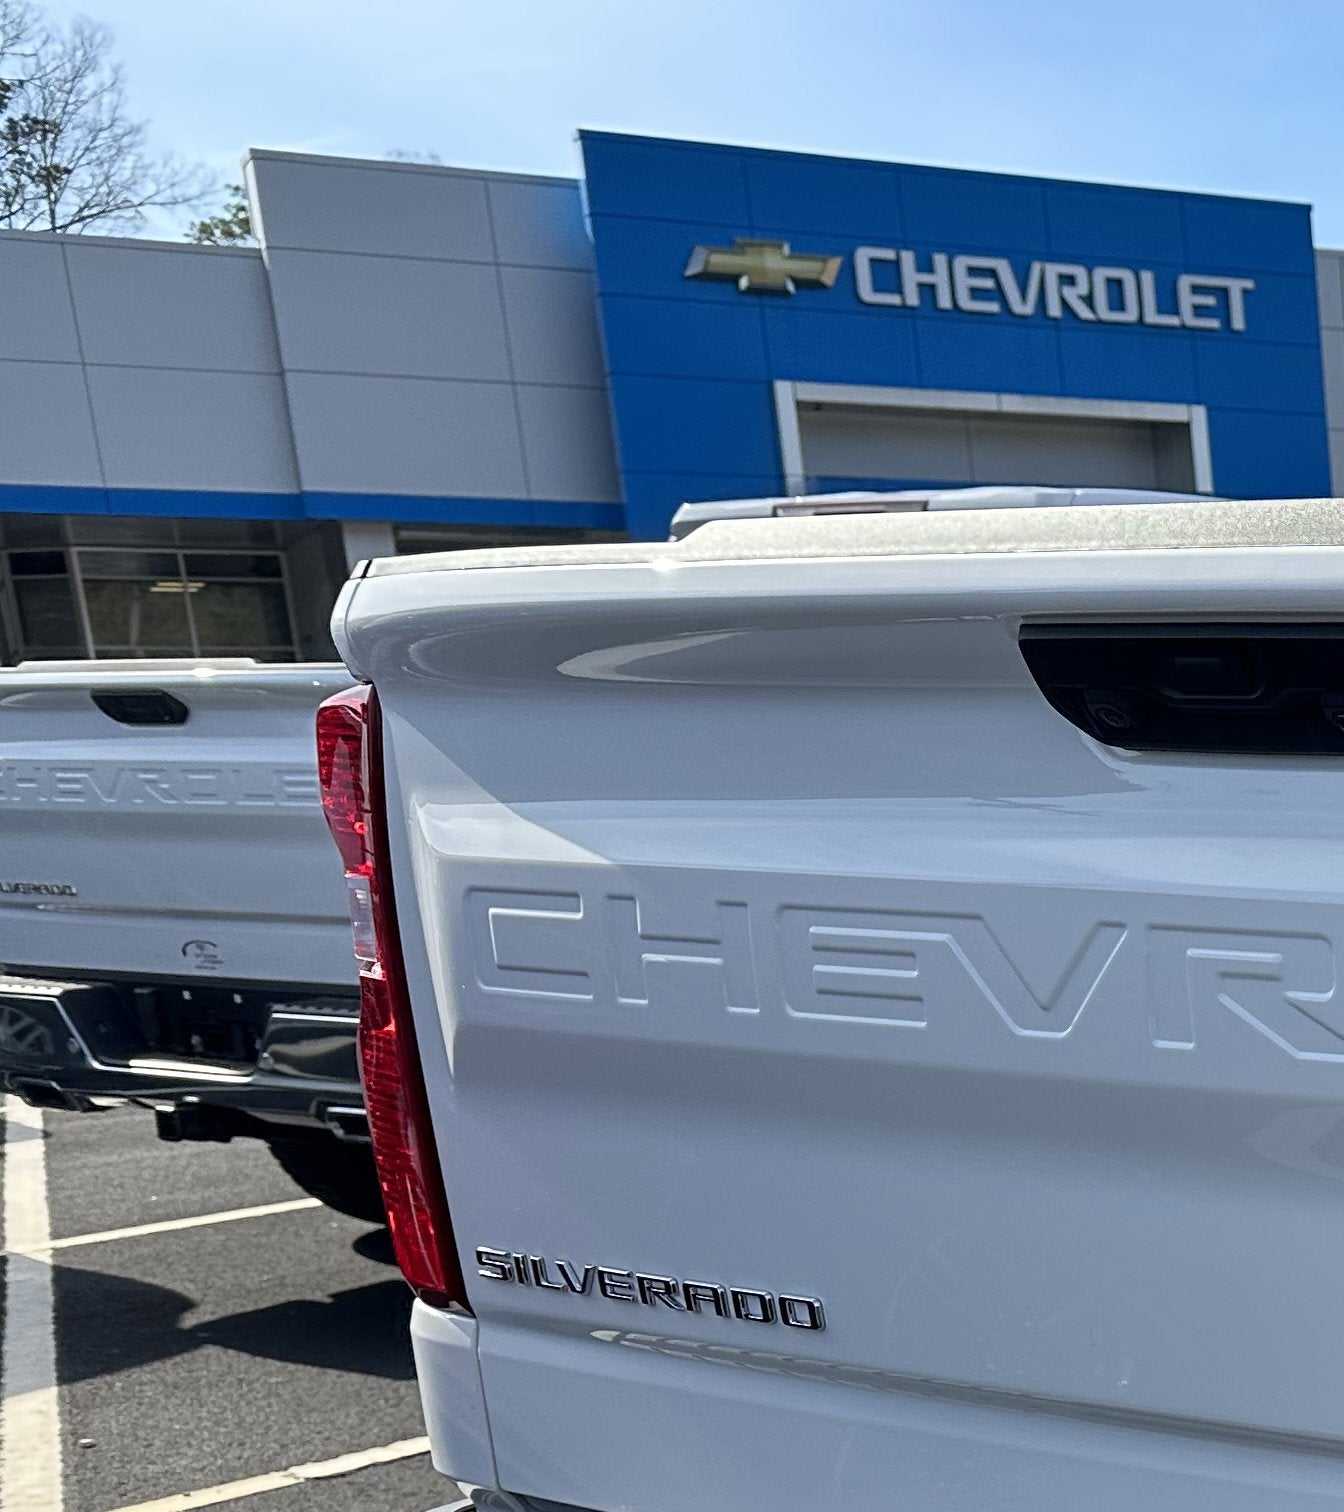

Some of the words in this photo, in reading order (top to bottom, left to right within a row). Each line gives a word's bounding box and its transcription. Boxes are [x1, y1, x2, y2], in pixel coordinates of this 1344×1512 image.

[853, 245, 1255, 332] CHEVROLET
[0, 766, 319, 806] HEVROLE
[475, 1246, 826, 1331] SILVERADO
